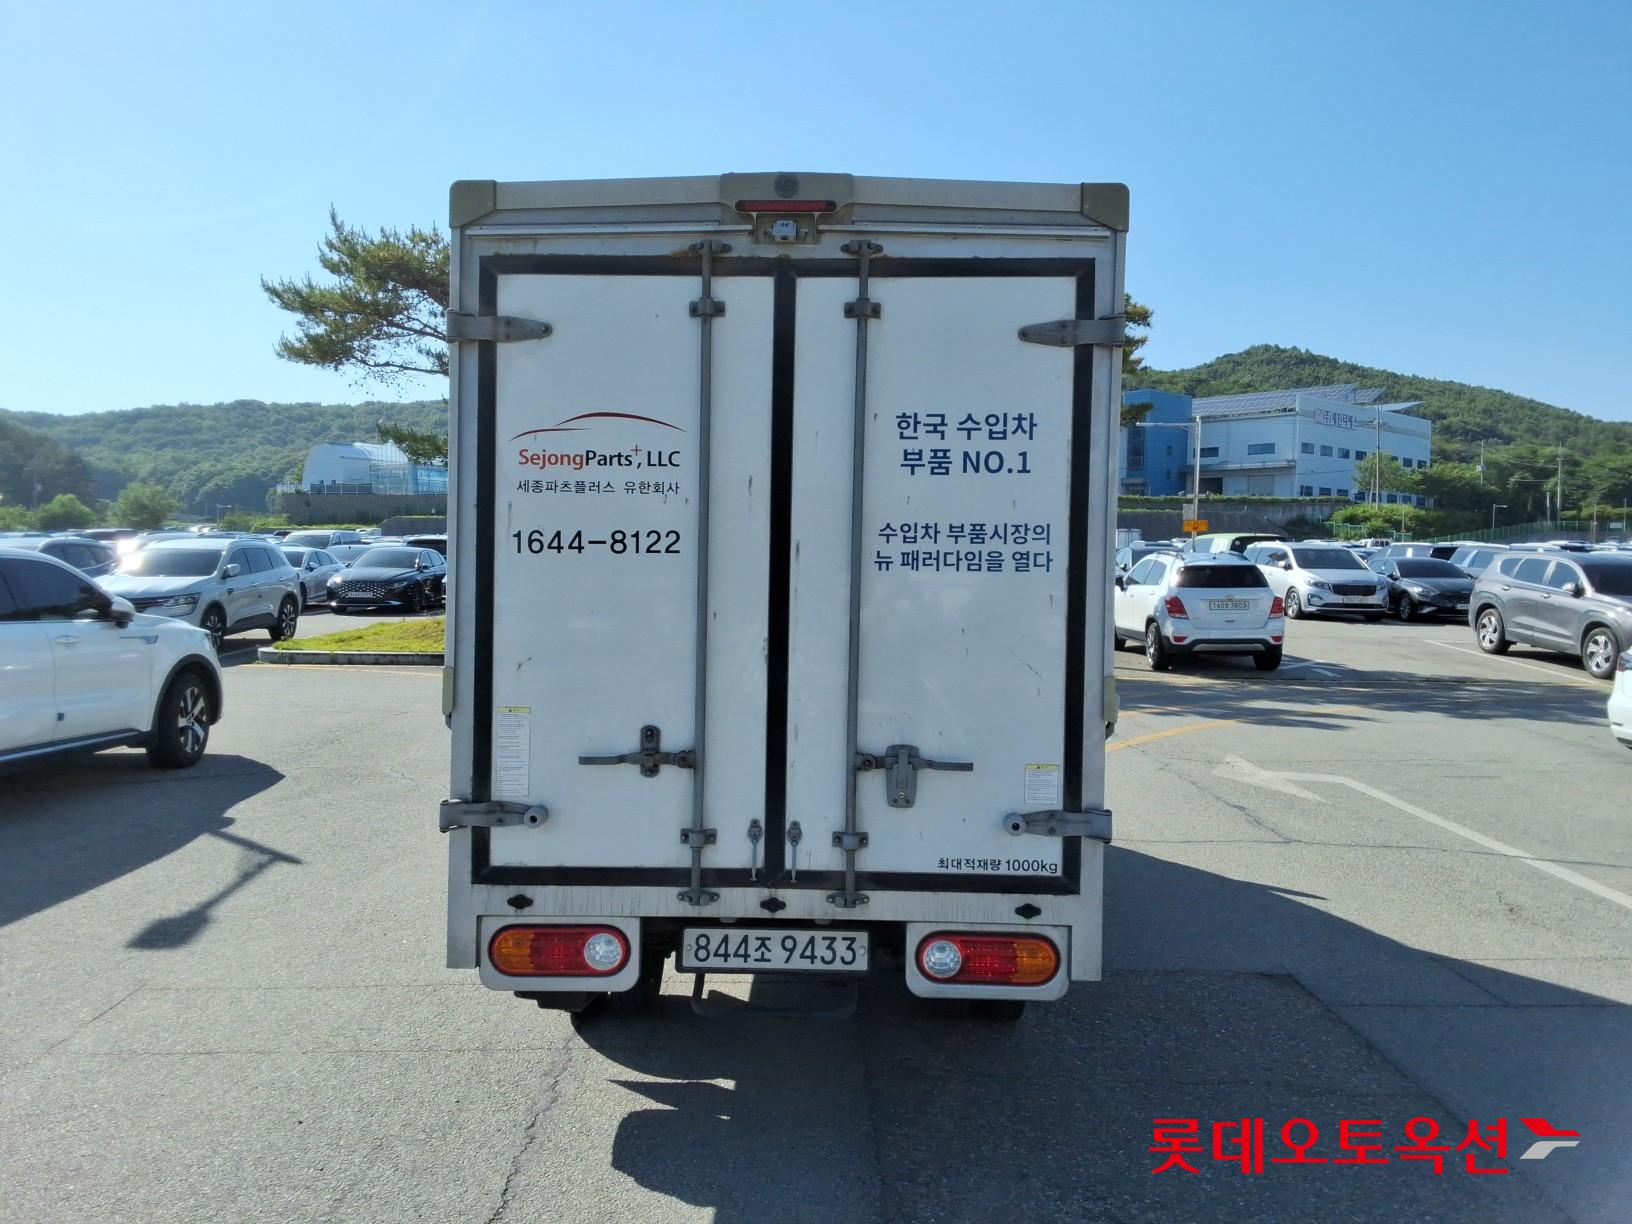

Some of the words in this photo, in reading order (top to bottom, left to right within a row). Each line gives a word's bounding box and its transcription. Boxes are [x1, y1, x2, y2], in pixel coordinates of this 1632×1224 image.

[896, 412, 948, 440] 한국
[957, 412, 1037, 440] 수입차
[647, 451, 680, 467] LLC
[901, 449, 952, 475] 부품
[962, 451, 1031, 474] NO.1
[516, 479, 616, 493] 세종파츠플러스
[623, 480, 680, 495] 유한회사
[512, 530, 681, 554] 1644-8122
[878, 522, 941, 544] 수입차
[946, 522, 1051, 545] 부품시장의
[874, 551, 894, 572] 뉴
[900, 550, 1005, 572] 패러다임을
[1011, 550, 1053, 572] 열다
[937, 857, 1002, 871] 최대적재량
[1005, 858, 1058, 874] 1000kg
